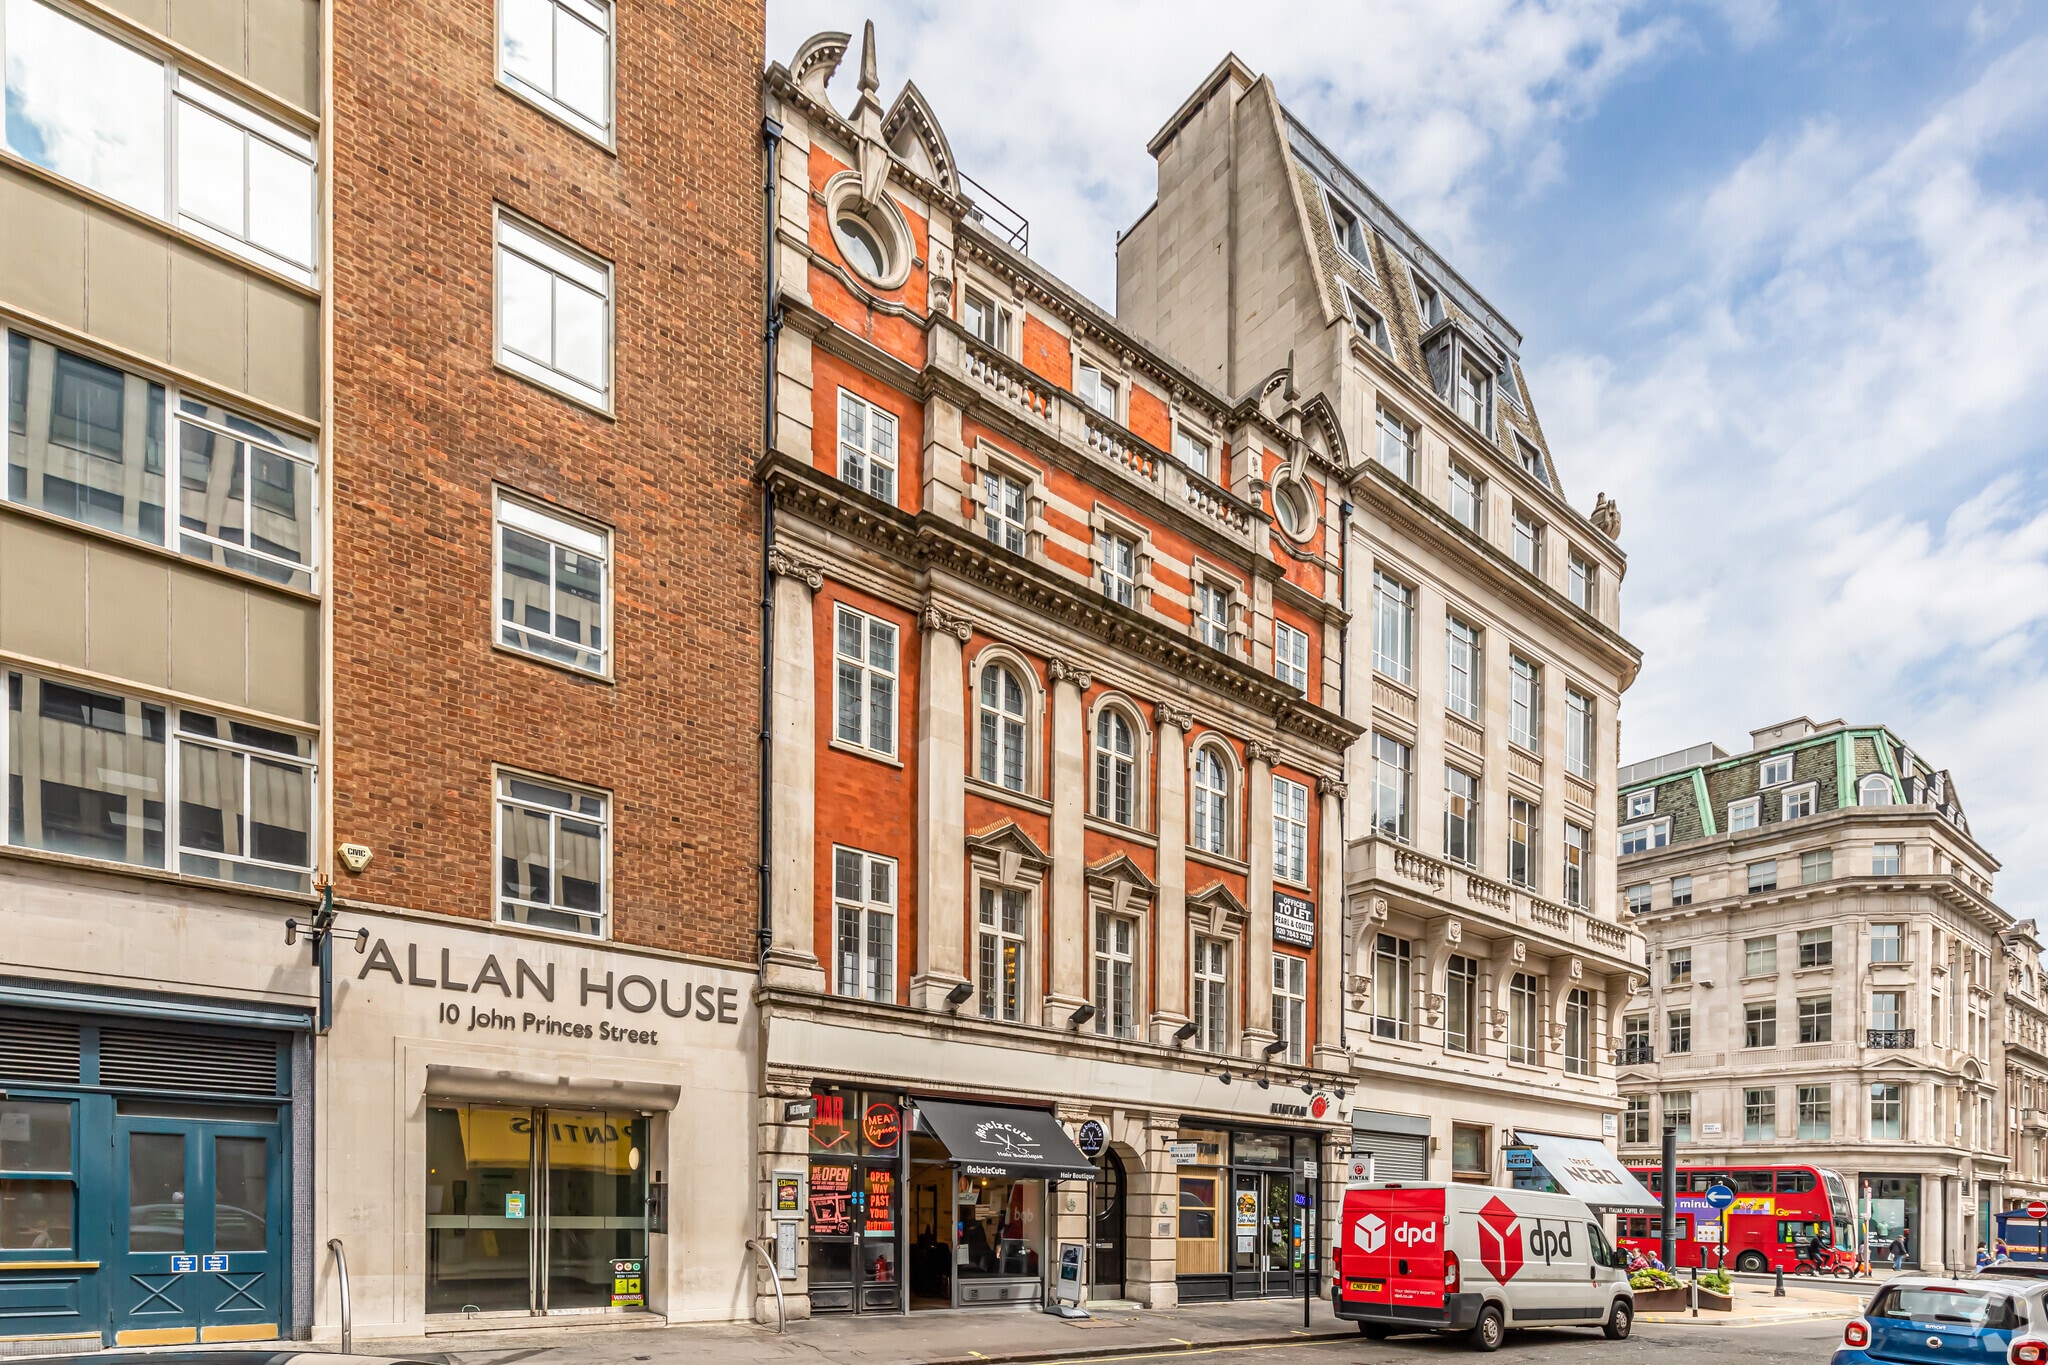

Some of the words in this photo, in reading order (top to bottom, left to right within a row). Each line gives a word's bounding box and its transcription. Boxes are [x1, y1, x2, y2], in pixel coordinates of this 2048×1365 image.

[347, 847, 366, 857] CIVIC
[1283, 897, 1307, 909] OFFICES
[1278, 902, 1291, 915] TO
[1293, 907, 1311, 920] LET
[1275, 915, 1289, 926] PEARL
[1295, 921, 1314, 932] COUTTS
[1276, 927, 1286, 935] 020
[357, 938, 555, 1002] ALLAN
[580, 967, 738, 1024] HOUSE
[439, 1002, 460, 1024] 10
[467, 1005, 515, 1031] John
[523, 1012, 593, 1039] Princes
[599, 1021, 658, 1045] Street
[813, 1094, 843, 1126] BAR
[1271, 1102, 1308, 1117] KINTAN
[868, 1114, 895, 1125] MEAT
[869, 1124, 897, 1140] liquor
[975, 1120, 1033, 1143] RebelzCutz
[1621, 1158, 1644, 1166] ORTH
[1645, 1158, 1662, 1166] FAC
[822, 1167, 850, 1181] OPEN
[966, 1165, 1007, 1175] RebelzCutz
[1060, 1171, 1072, 1179] Hair
[1072, 1172, 1095, 1180] Boutique
[1562, 1165, 1623, 1185] NERO
[870, 1171, 890, 1183] OPEN
[872, 1184, 888, 1194] WAY
[870, 1195, 890, 1207] PAST
[869, 1208, 889, 1219] YOUR
[1776, 1208, 1789, 1216] Go
[1394, 1221, 1436, 1248] dpd
[1530, 1218, 1572, 1266] dpd
